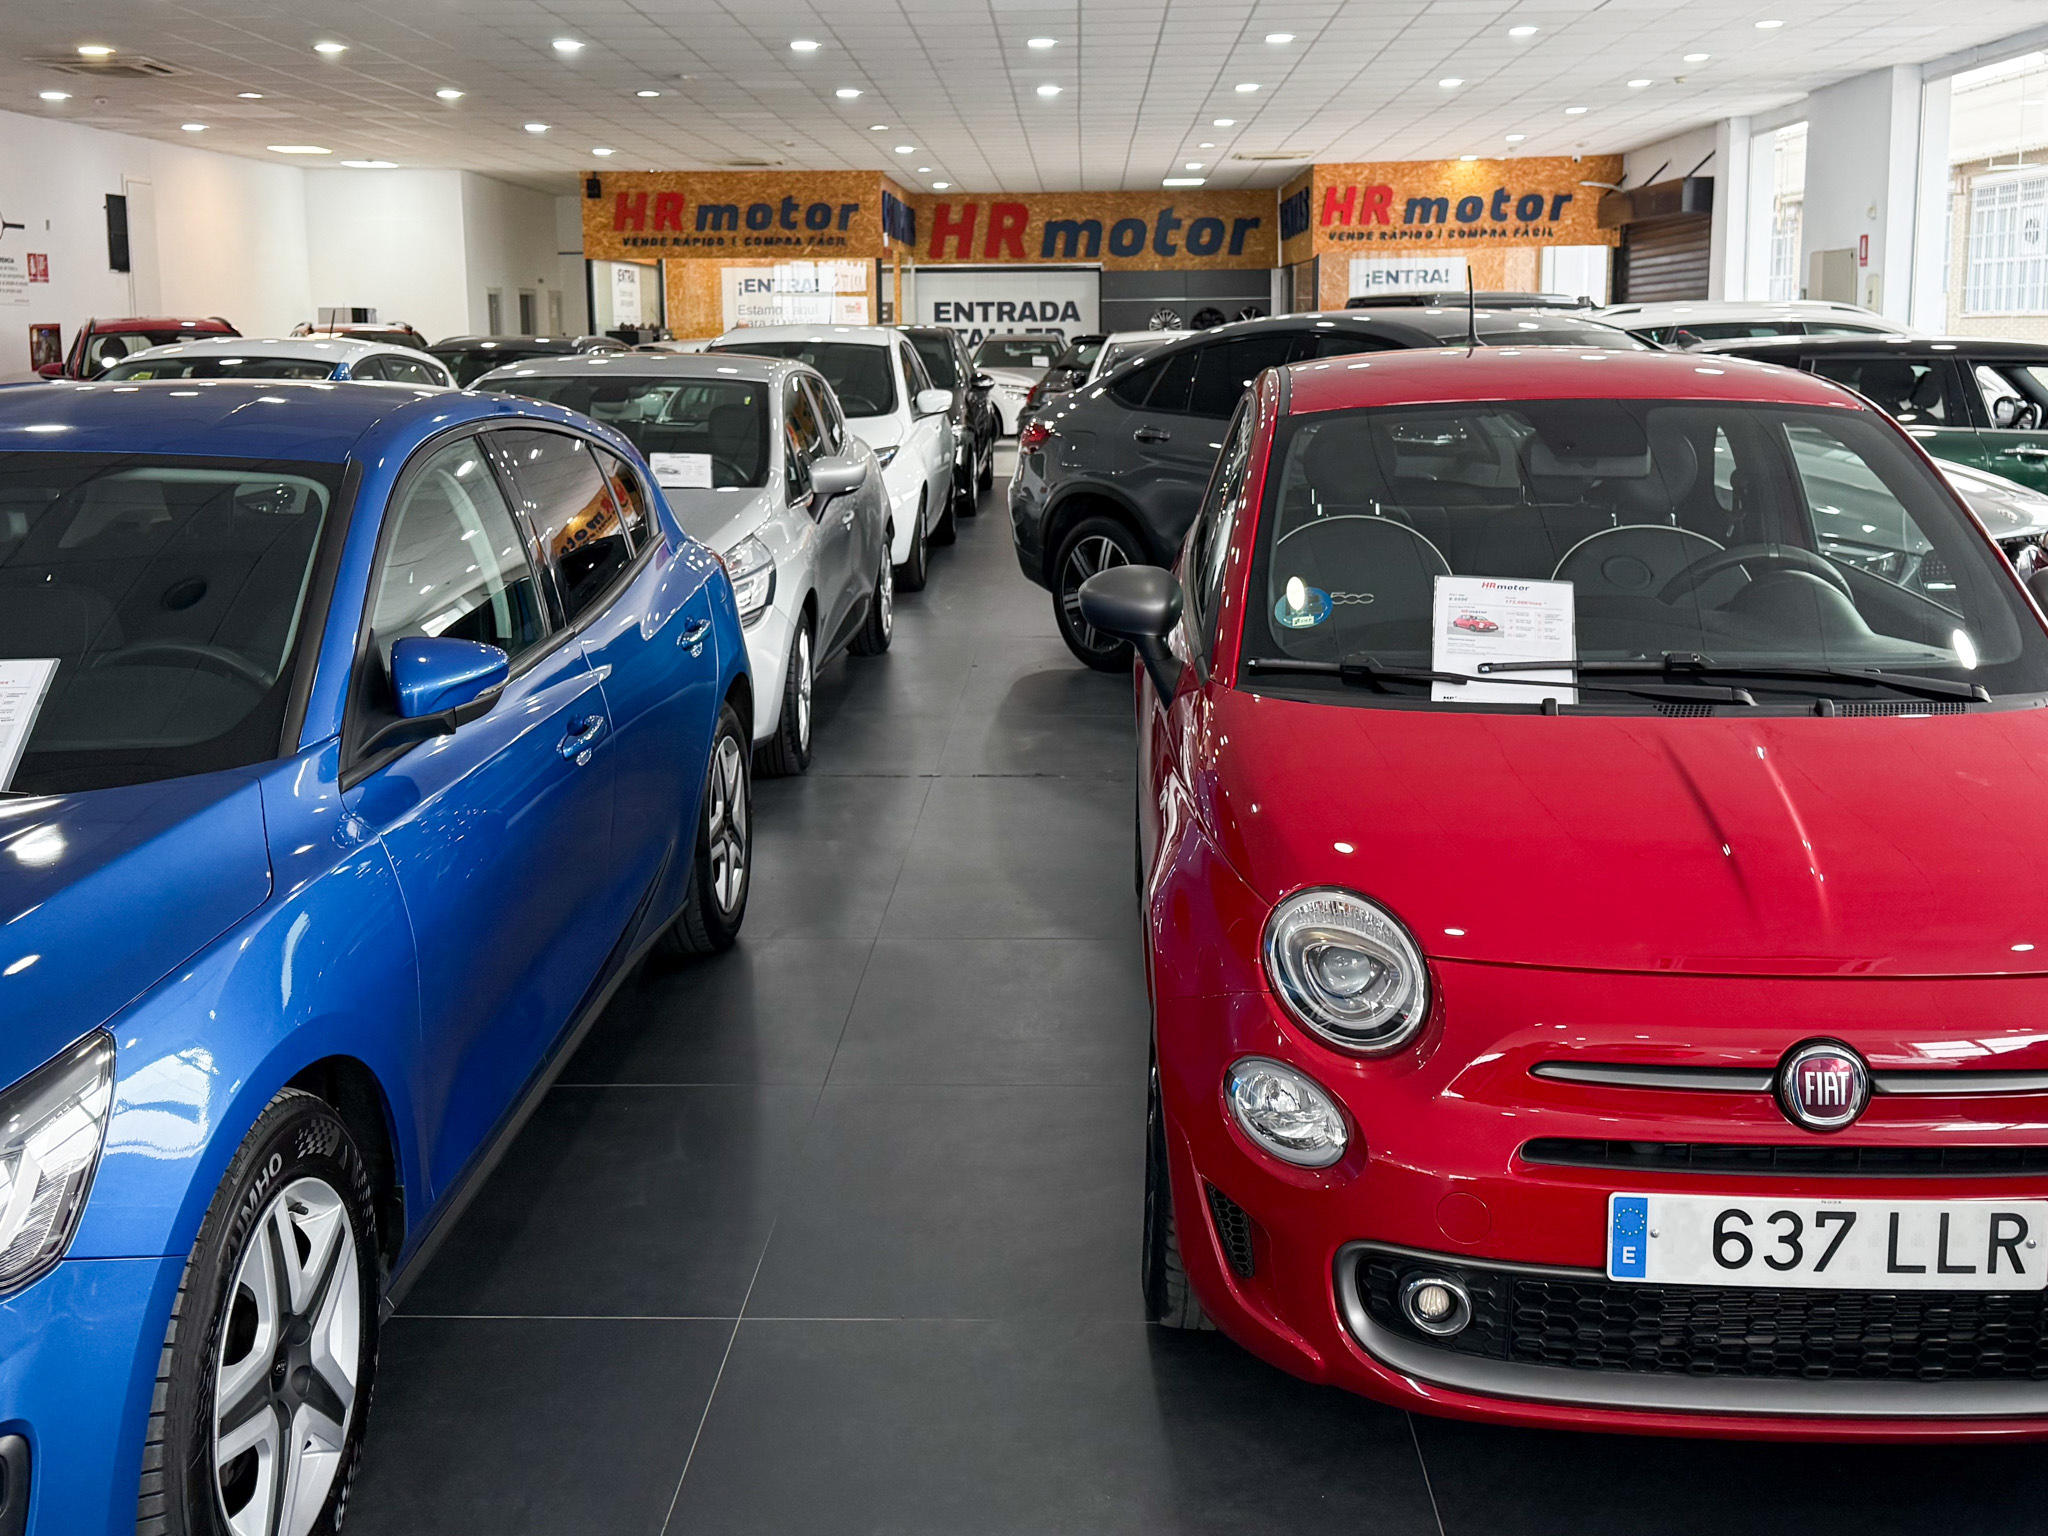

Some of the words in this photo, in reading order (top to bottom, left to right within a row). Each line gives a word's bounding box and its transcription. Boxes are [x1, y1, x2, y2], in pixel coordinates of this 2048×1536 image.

[613, 192, 685, 232] HR
[695, 195, 859, 232] motor
[1319, 185, 1394, 227] HR
[1403, 187, 1573, 225] motor
[622, 236, 667, 247] VENDE
[743, 236, 803, 247] COMPRA
[928, 202, 1029, 260] HR
[1041, 206, 1261, 258] motor
[1328, 231, 1375, 242] VENDE
[1447, 228, 1507, 240] COMPRA
[1365, 269, 1449, 288] ¡ENTRA!
[934, 301, 1081, 323] ENTRADA
[1804, 1071, 1850, 1106] FIAT
[1622, 1246, 1637, 1265] E
[1712, 1208, 1857, 1273] 637
[1887, 1212, 2030, 1275] LLR
